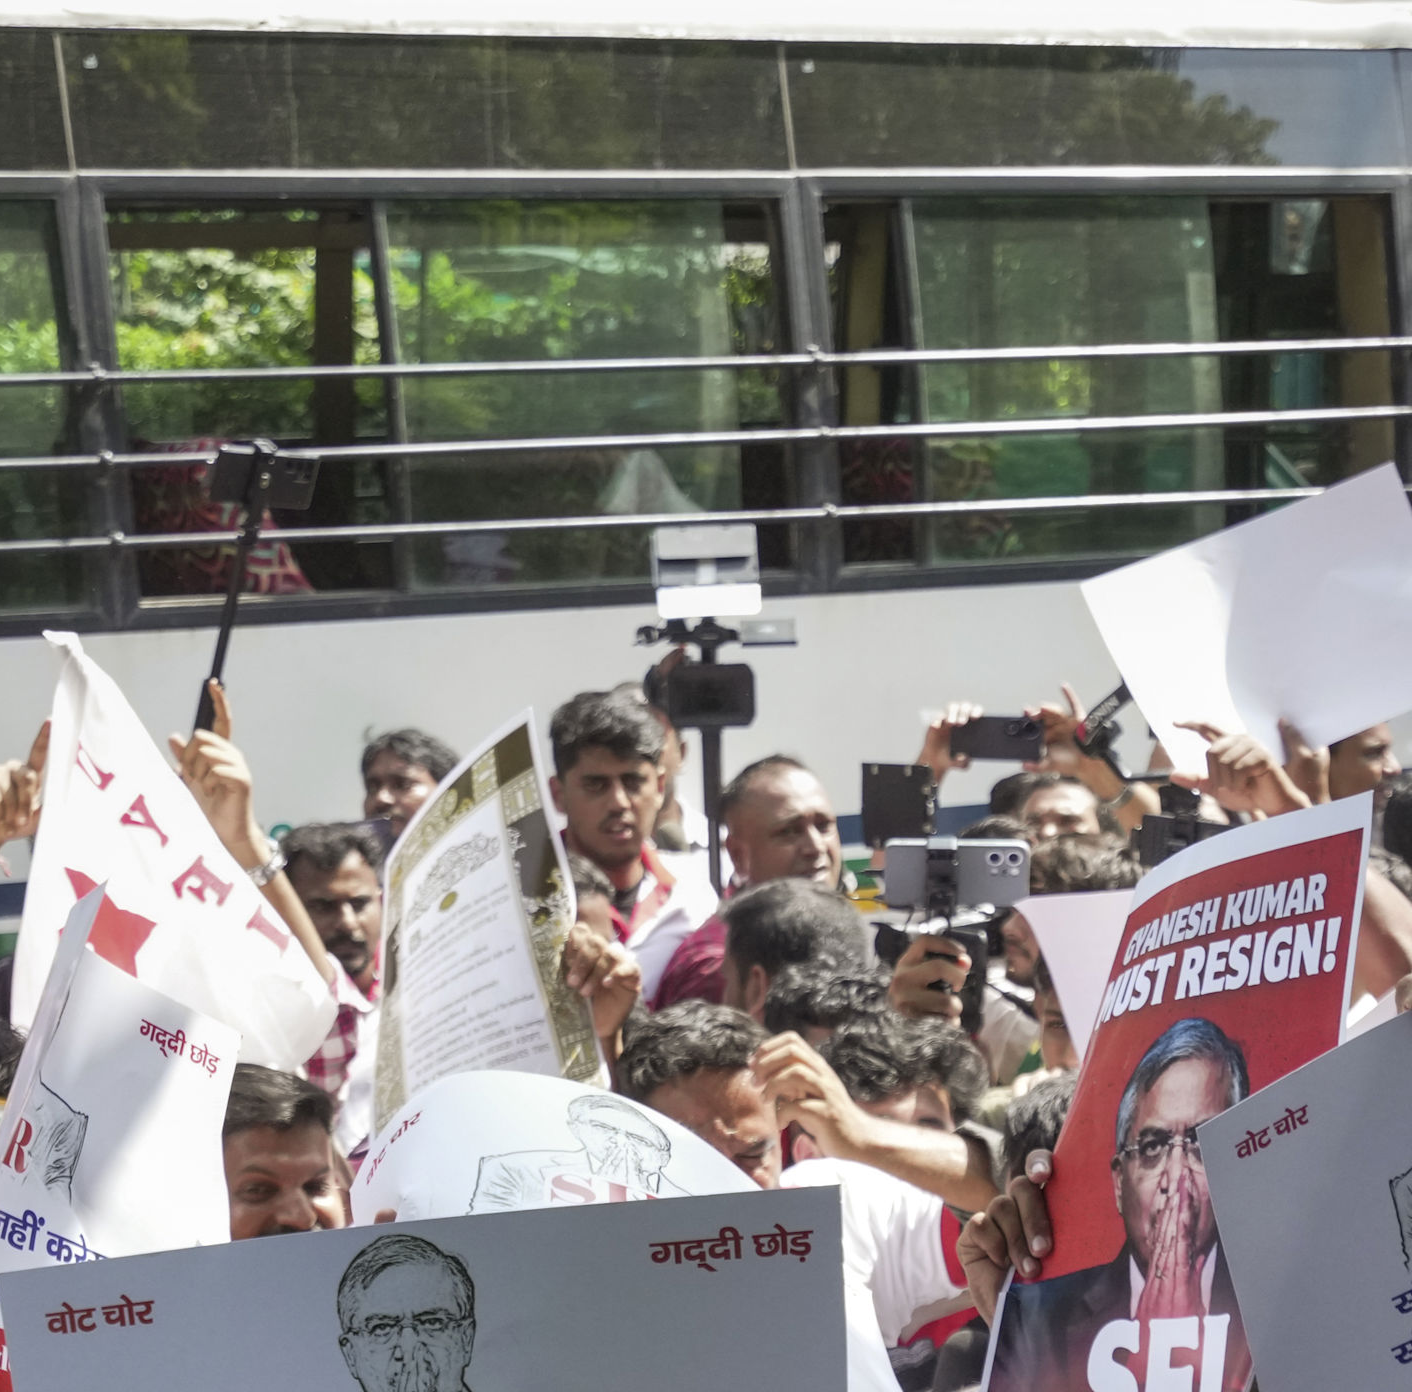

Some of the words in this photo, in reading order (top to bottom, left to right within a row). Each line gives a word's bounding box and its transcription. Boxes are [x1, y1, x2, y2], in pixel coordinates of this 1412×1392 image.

[1122, 896, 1223, 967] GYANESH
[1221, 873, 1328, 931] KUMAR
[1099, 951, 1177, 1024] MUST
[1174, 916, 1342, 1002] RESIGN!
[189, 1044, 222, 1079] छोड़
[1234, 1127, 1272, 1161] वोट
[1272, 1104, 1311, 1142] चोर
[649, 1226, 745, 1272] गद्दी
[751, 1222, 815, 1264] छोड़
[45, 1300, 97, 1336] वोट
[101, 1294, 155, 1329] चोर
